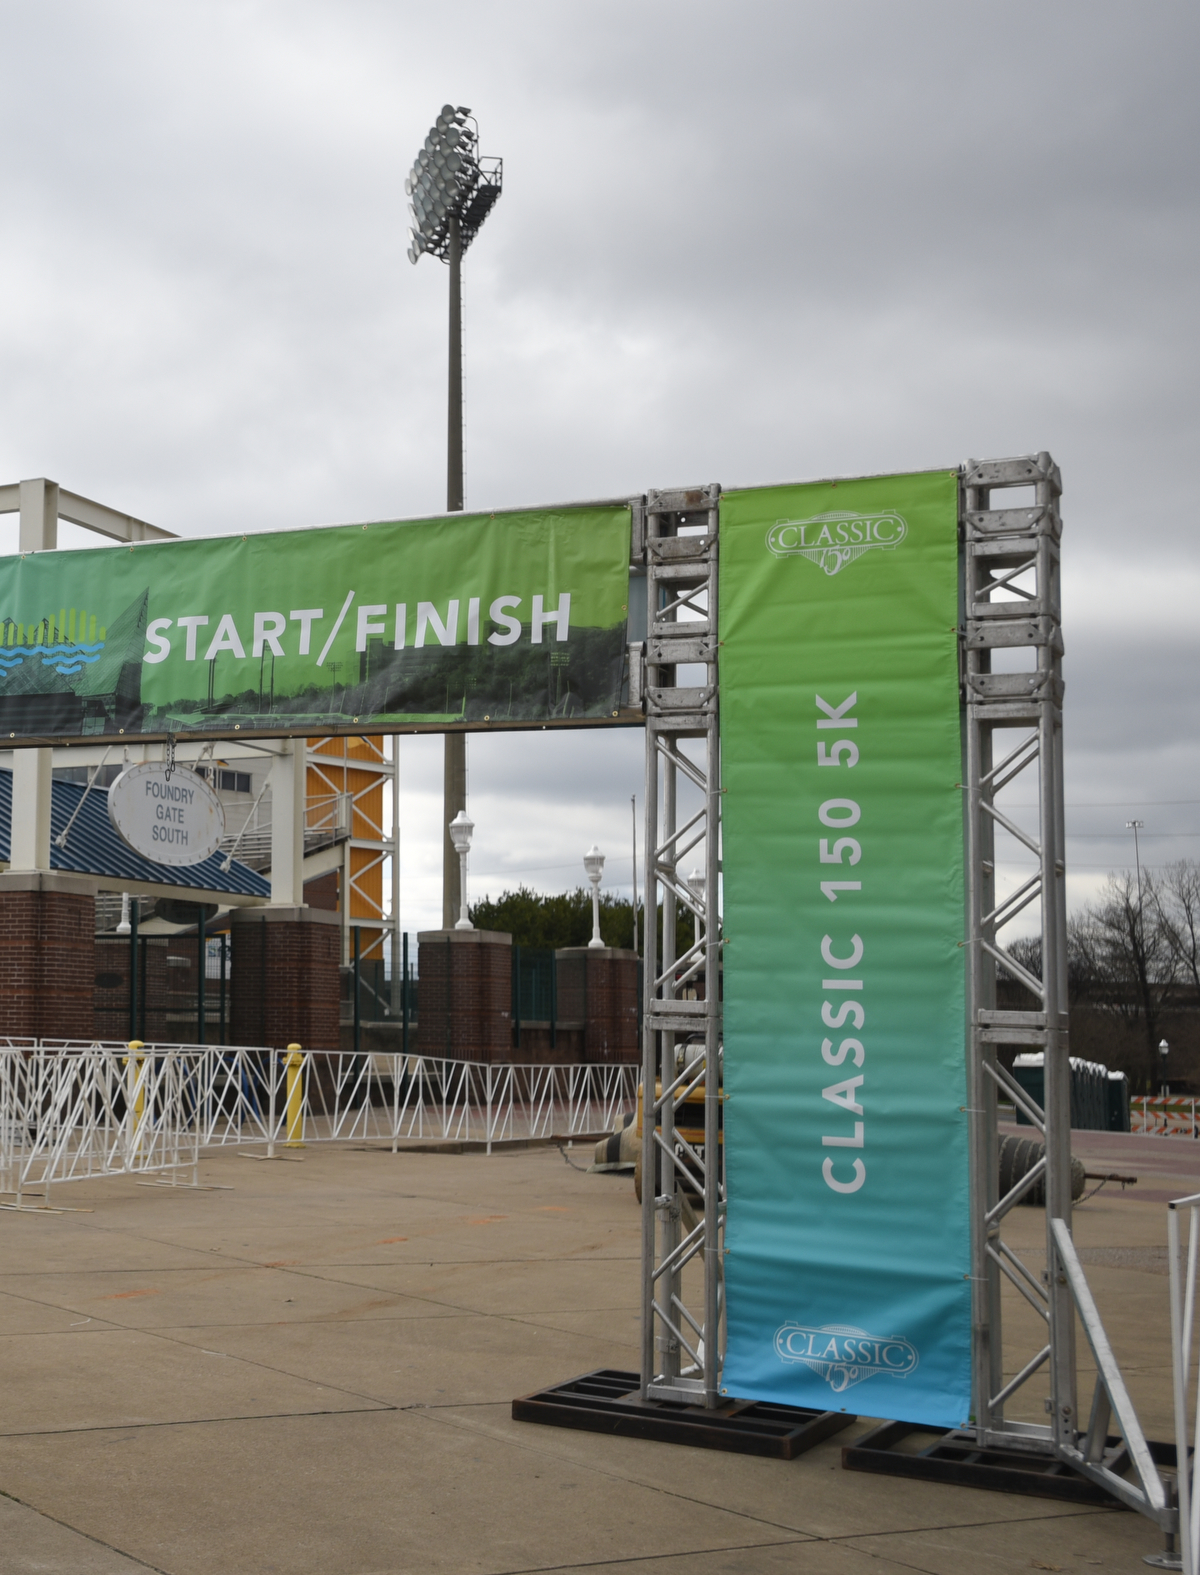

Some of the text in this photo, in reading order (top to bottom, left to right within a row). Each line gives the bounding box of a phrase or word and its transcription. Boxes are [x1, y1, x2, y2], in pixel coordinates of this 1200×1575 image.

[778, 519, 895, 549] CLASSIC
[142, 590, 571, 667] START/FINISH
[146, 780, 195, 805] FOUNDRY
[156, 804, 184, 824] GATE
[152, 825, 189, 846] SOUTH
[815, 690, 866, 1194] CLASSIC 150 5K
[674, 1143, 706, 1160] CT
[786, 1331, 905, 1367] CLASSIC
